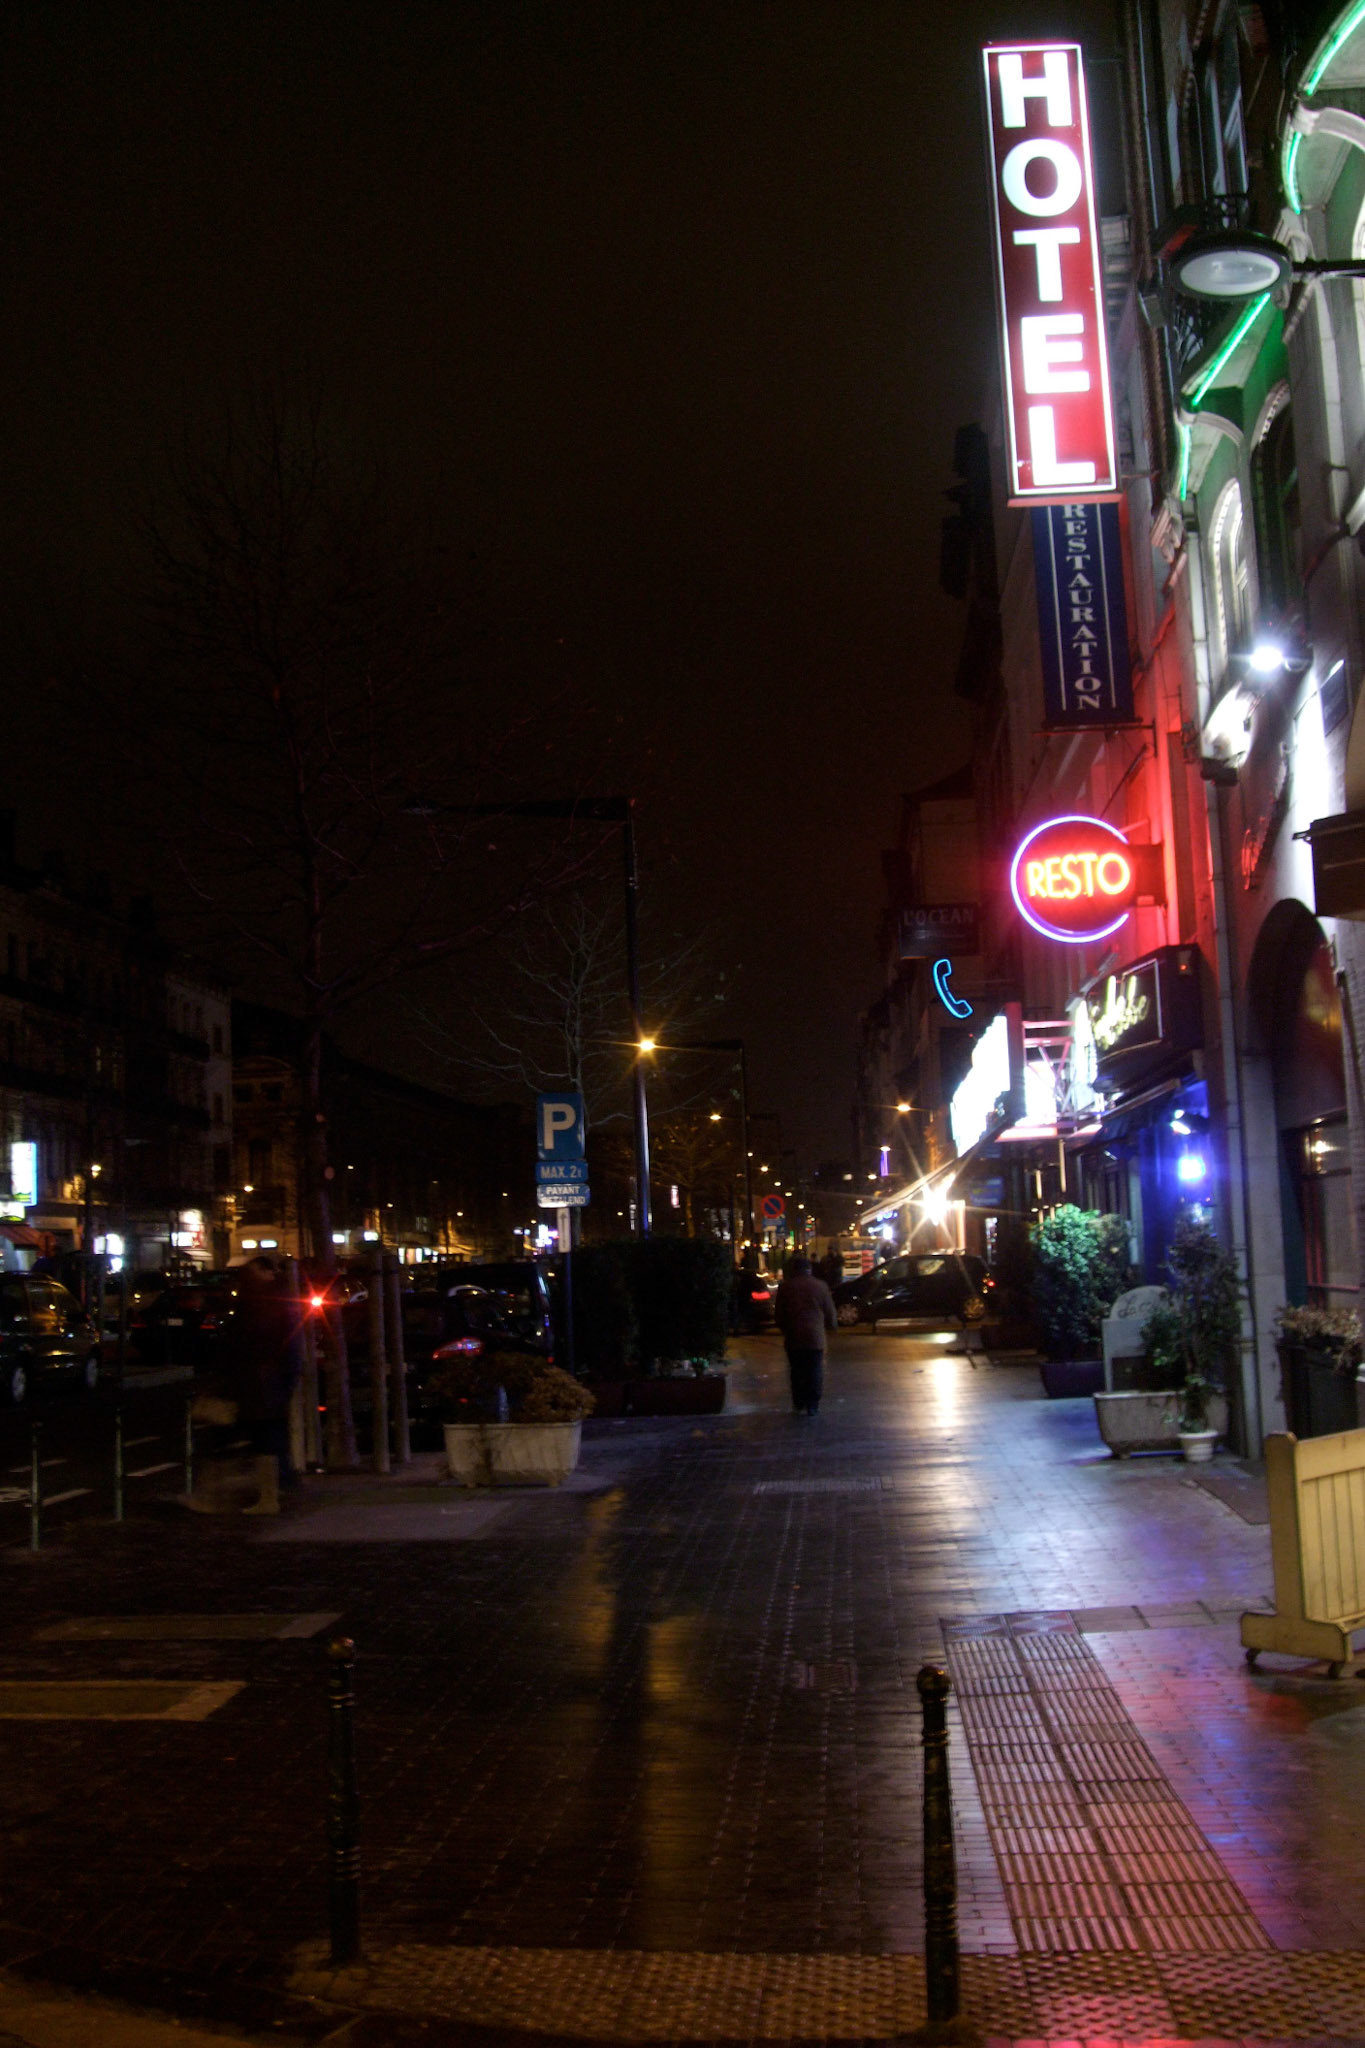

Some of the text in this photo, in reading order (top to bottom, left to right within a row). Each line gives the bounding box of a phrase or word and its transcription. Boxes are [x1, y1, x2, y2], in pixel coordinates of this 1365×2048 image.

[998, 51, 1096, 486] HOTEL
[1062, 504, 1102, 710] RESTAURATION
[1026, 852, 1130, 899] RESTO
[542, 1102, 577, 1150] P
[545, 1185, 580, 1195] PAYANT
